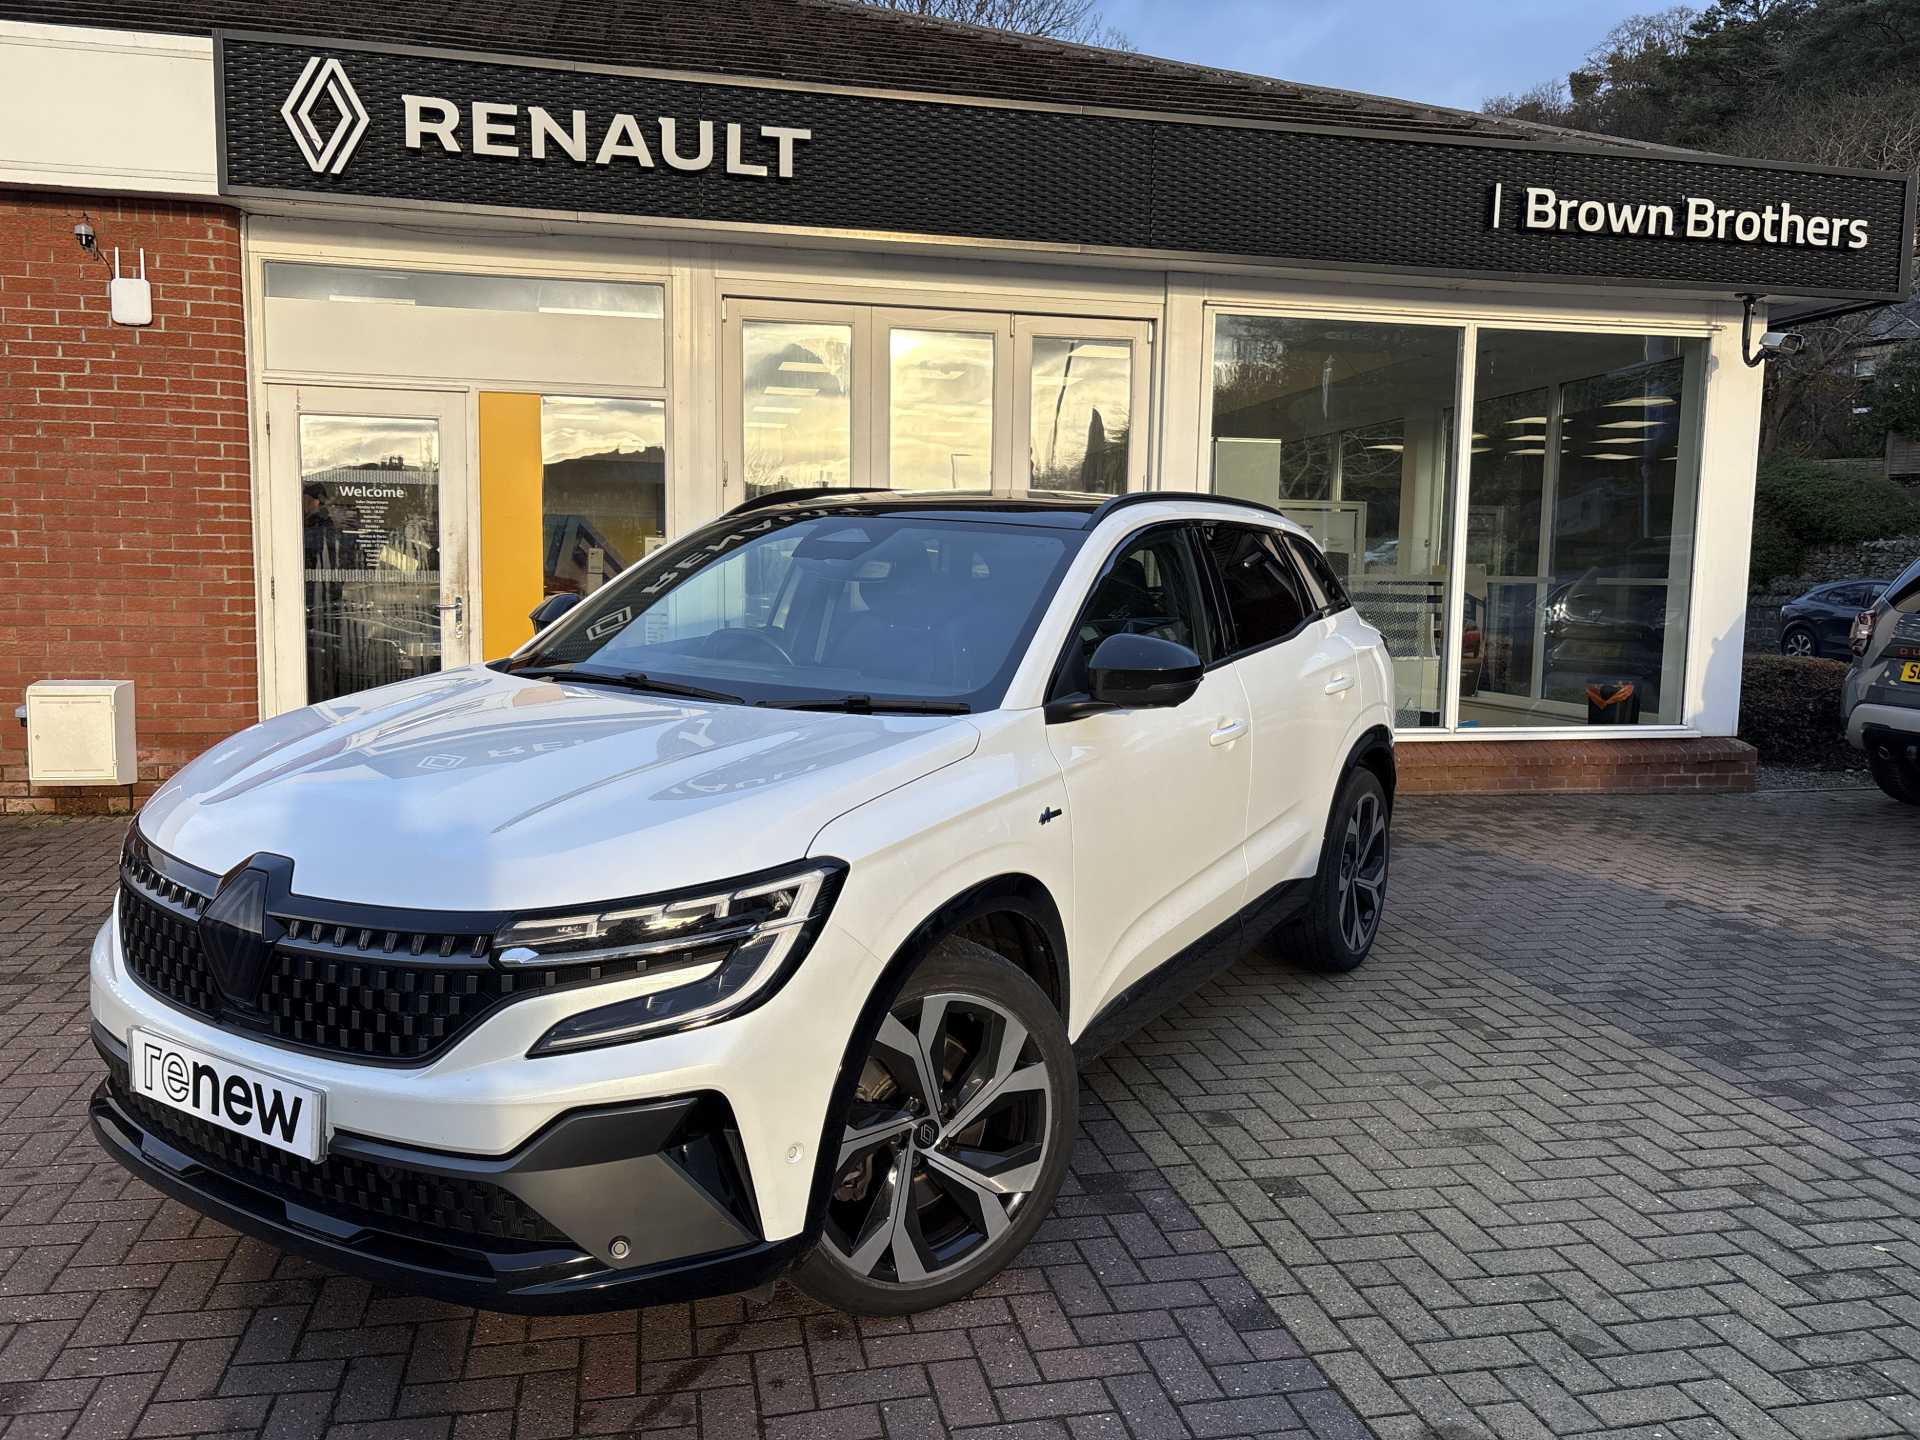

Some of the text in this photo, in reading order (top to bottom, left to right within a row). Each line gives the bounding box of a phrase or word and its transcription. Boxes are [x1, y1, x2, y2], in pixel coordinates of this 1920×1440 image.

[401, 93, 812, 178] RENAULT
[1525, 187, 1869, 250] Brown Brothers
[339, 485, 405, 498] Welcome
[144, 1042, 302, 1144] renew
